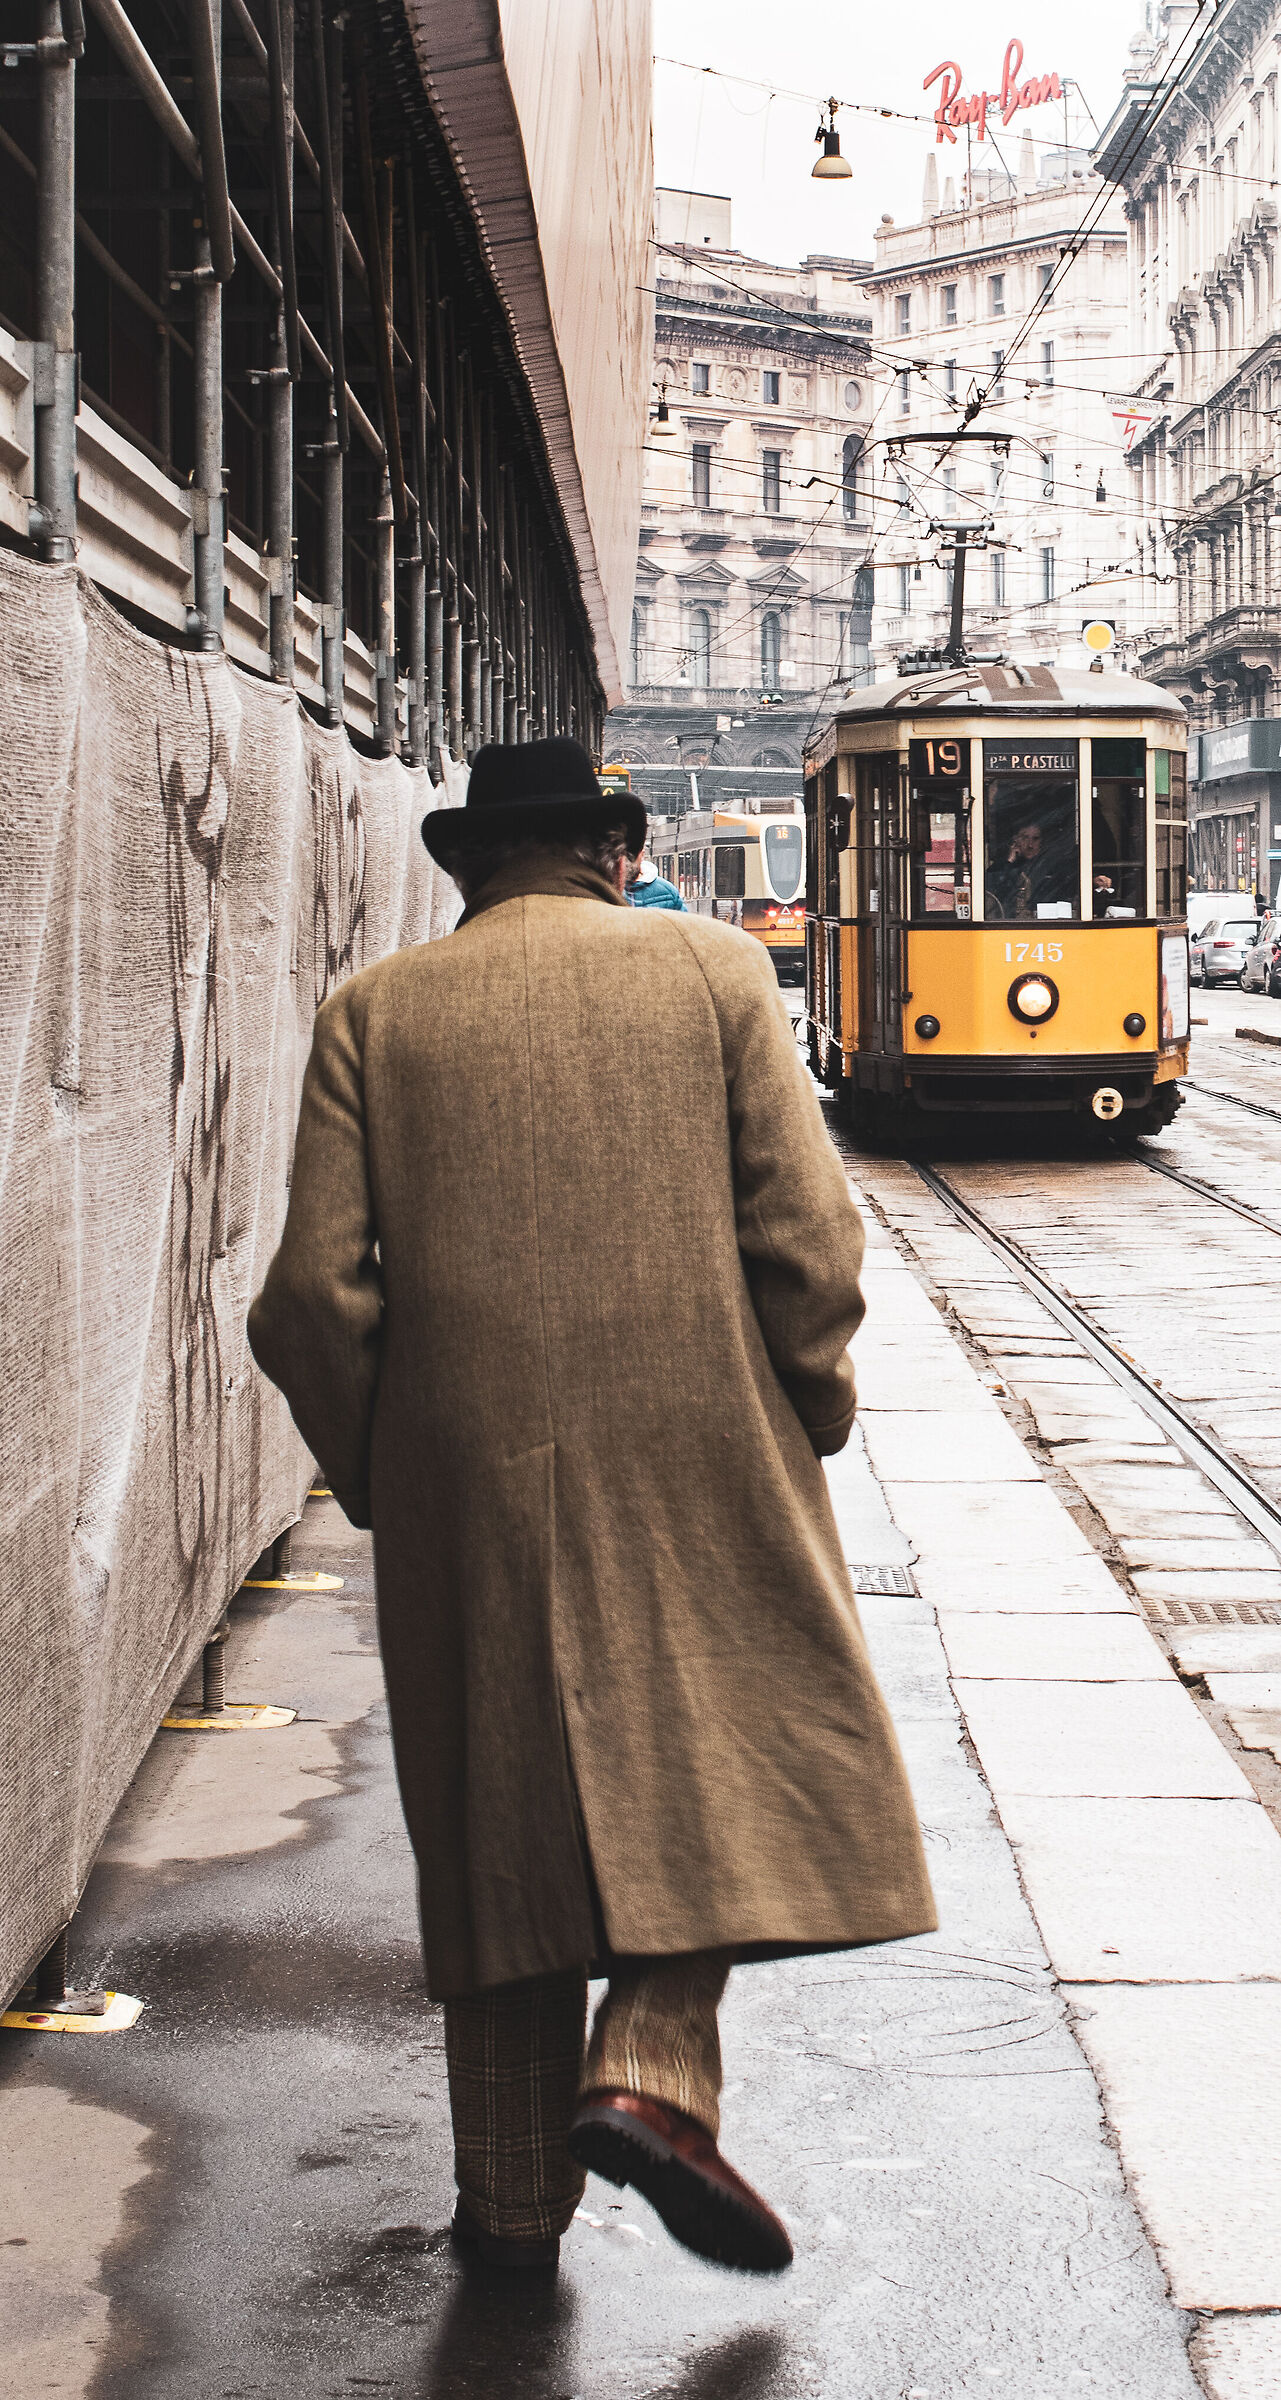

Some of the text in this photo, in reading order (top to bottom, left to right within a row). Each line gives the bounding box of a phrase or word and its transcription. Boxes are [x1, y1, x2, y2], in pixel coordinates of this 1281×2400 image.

[923, 38, 1062, 144] Ray-Ban
[925, 741, 961, 775] 19
[1023, 755, 1075, 769] CASTELLI
[959, 905, 970, 917] 19
[1005, 942, 1063, 962] 1745
